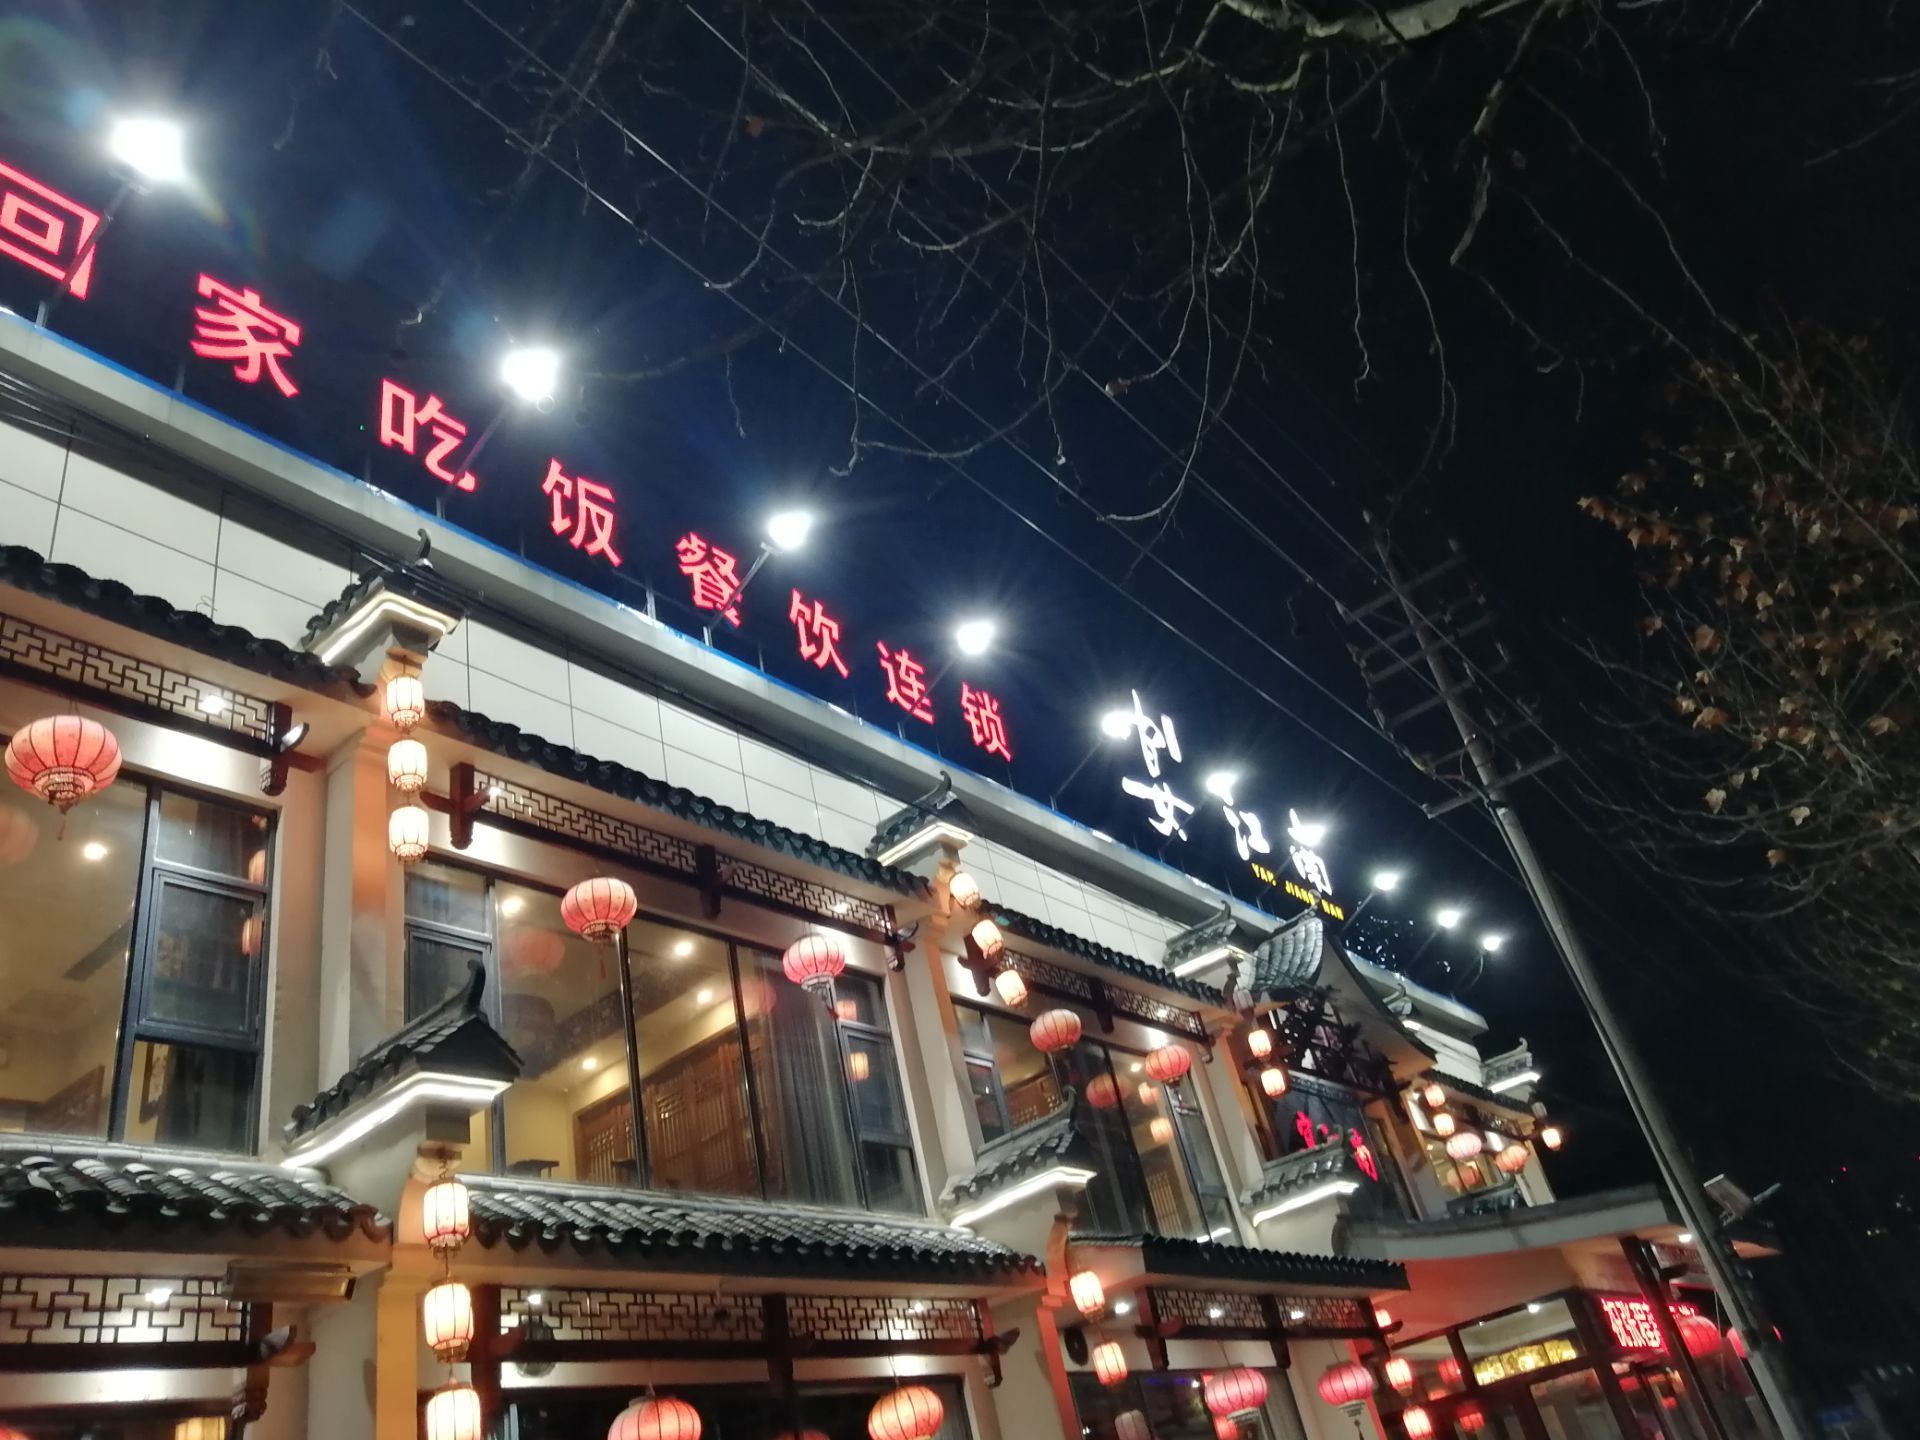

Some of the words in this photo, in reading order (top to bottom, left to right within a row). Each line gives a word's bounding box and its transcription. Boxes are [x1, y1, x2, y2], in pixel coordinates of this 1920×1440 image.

[0, 161, 1012, 763] 回家吃饭餐饮连锁
